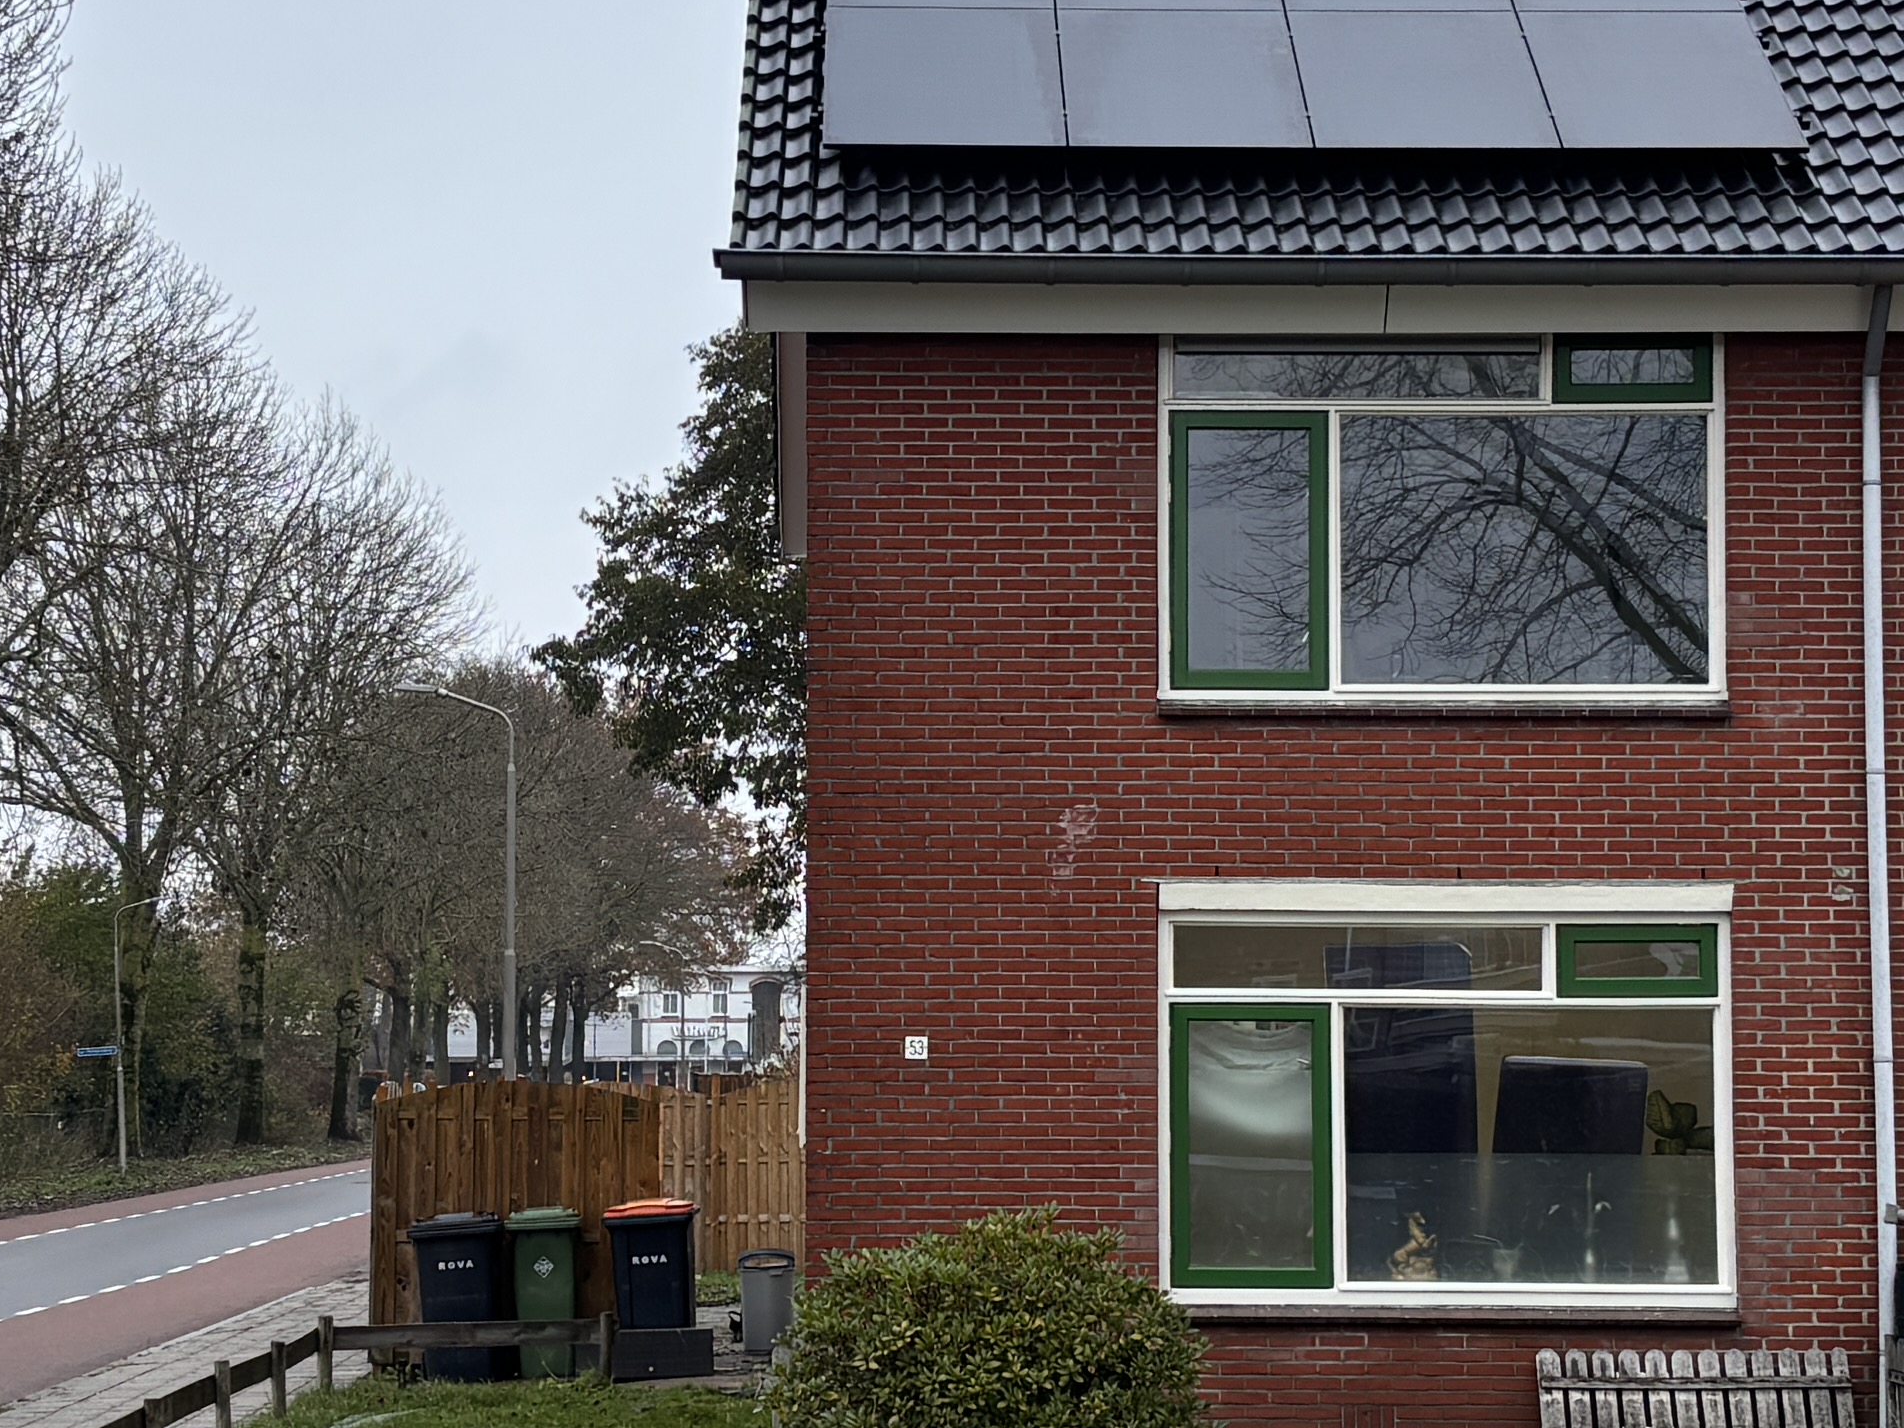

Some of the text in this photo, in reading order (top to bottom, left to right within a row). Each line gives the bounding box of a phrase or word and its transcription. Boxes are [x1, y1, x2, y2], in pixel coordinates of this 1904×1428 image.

[909, 1040, 924, 1056] 53
[632, 1254, 668, 1265] ROVA
[438, 1260, 474, 1271] ROVA
